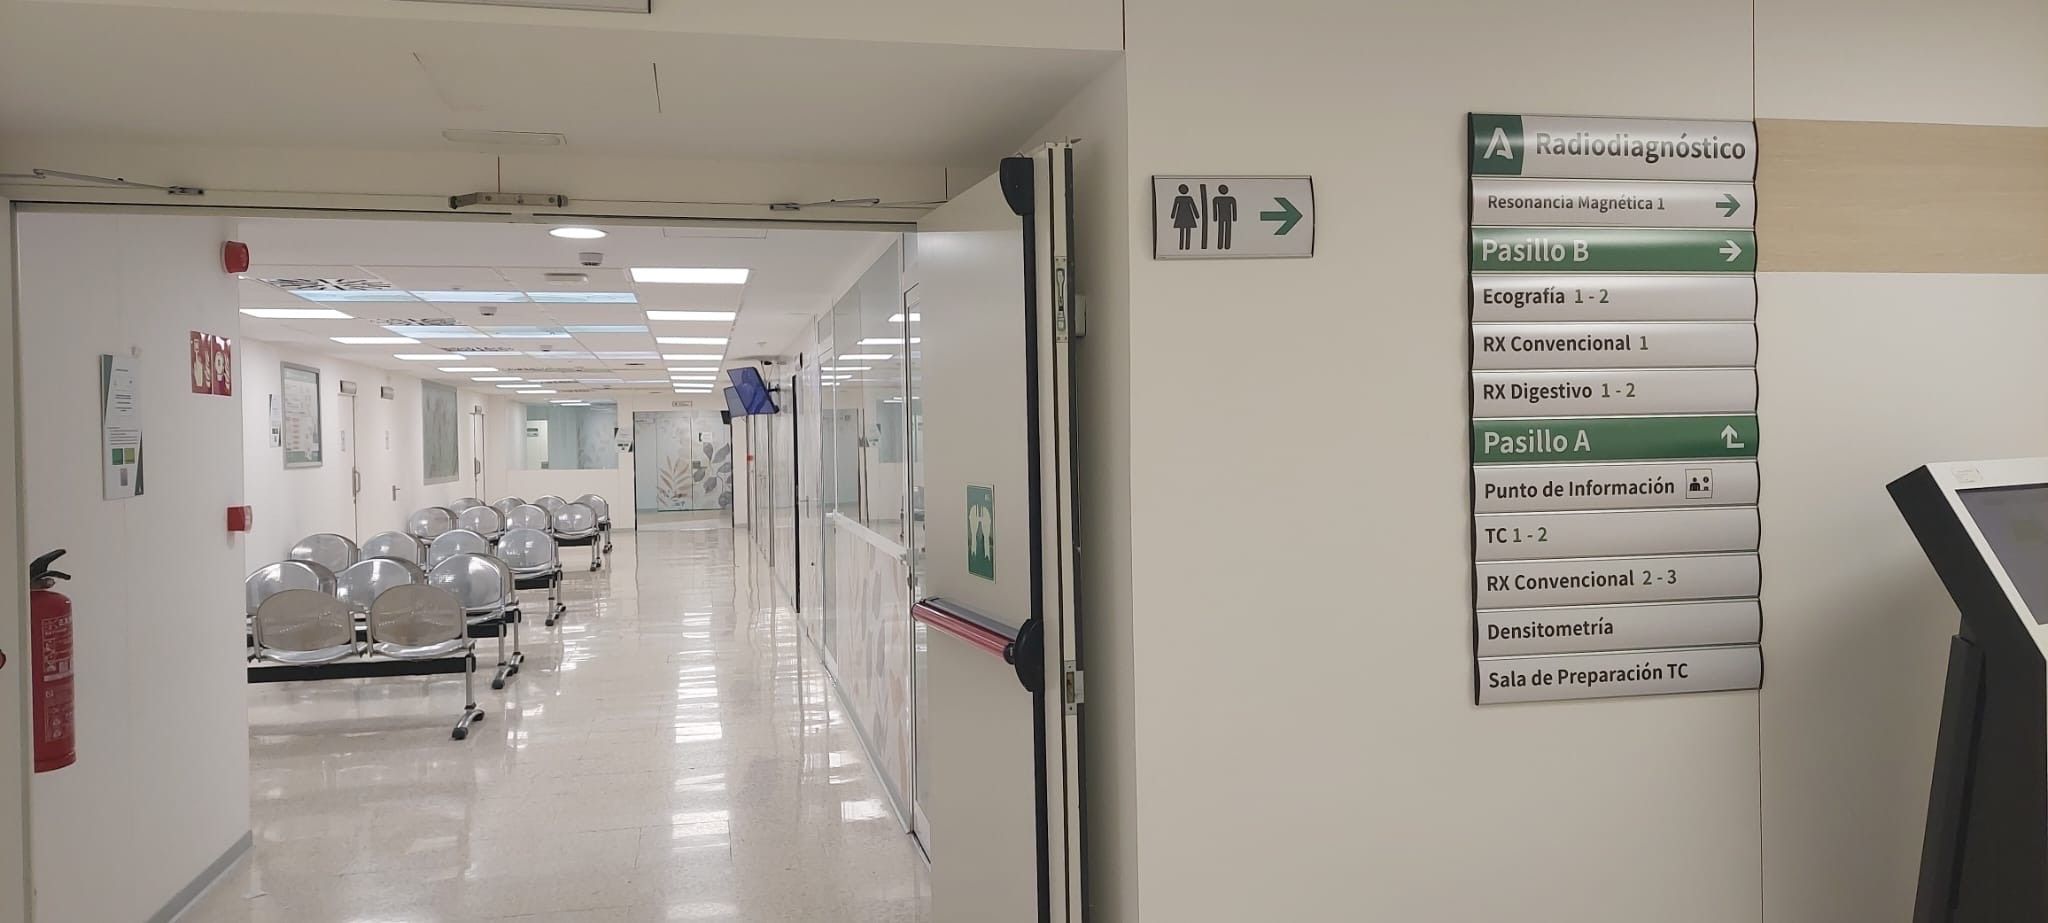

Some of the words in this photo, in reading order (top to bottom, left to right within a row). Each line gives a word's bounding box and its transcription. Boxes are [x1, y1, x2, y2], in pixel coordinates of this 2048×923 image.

[1536, 132, 1745, 164] Radiodiagnóstico
[1488, 195, 1573, 210] Resonancia
[1578, 195, 1653, 212] Magnética
[1657, 198, 1664, 210] 1
[1482, 238, 1565, 262] Pasillo
[1573, 240, 1588, 261] B
[1484, 287, 1565, 308] Ecografía
[1575, 289, 1583, 303] 1
[1599, 289, 1609, 303] 2
[1483, 336, 1505, 352] RX
[1511, 334, 1631, 351] Convencional
[1640, 336, 1648, 350] 1
[1483, 384, 1505, 399] RX
[1511, 382, 1592, 403] Digestivo
[1602, 384, 1610, 397] 1
[1626, 383, 1635, 397] 2
[1484, 430, 1567, 453] Pasillo
[1574, 430, 1591, 451] A
[1485, 482, 1537, 498] Punto
[1543, 481, 1563, 496] de
[1569, 476, 1674, 496] Información
[1485, 528, 1507, 543] TC
[1513, 529, 1521, 542] 1
[1538, 527, 1547, 541] 2
[1487, 576, 1509, 591] RX
[1515, 570, 1634, 590] Convencional
[1643, 571, 1652, 584] 2
[1667, 570, 1677, 584] 3
[1488, 617, 1613, 640] Densitometría
[1489, 671, 1526, 688] Sala
[1532, 669, 1552, 685] de
[1558, 663, 1662, 687] Preparación
[1667, 663, 1688, 679] TC
